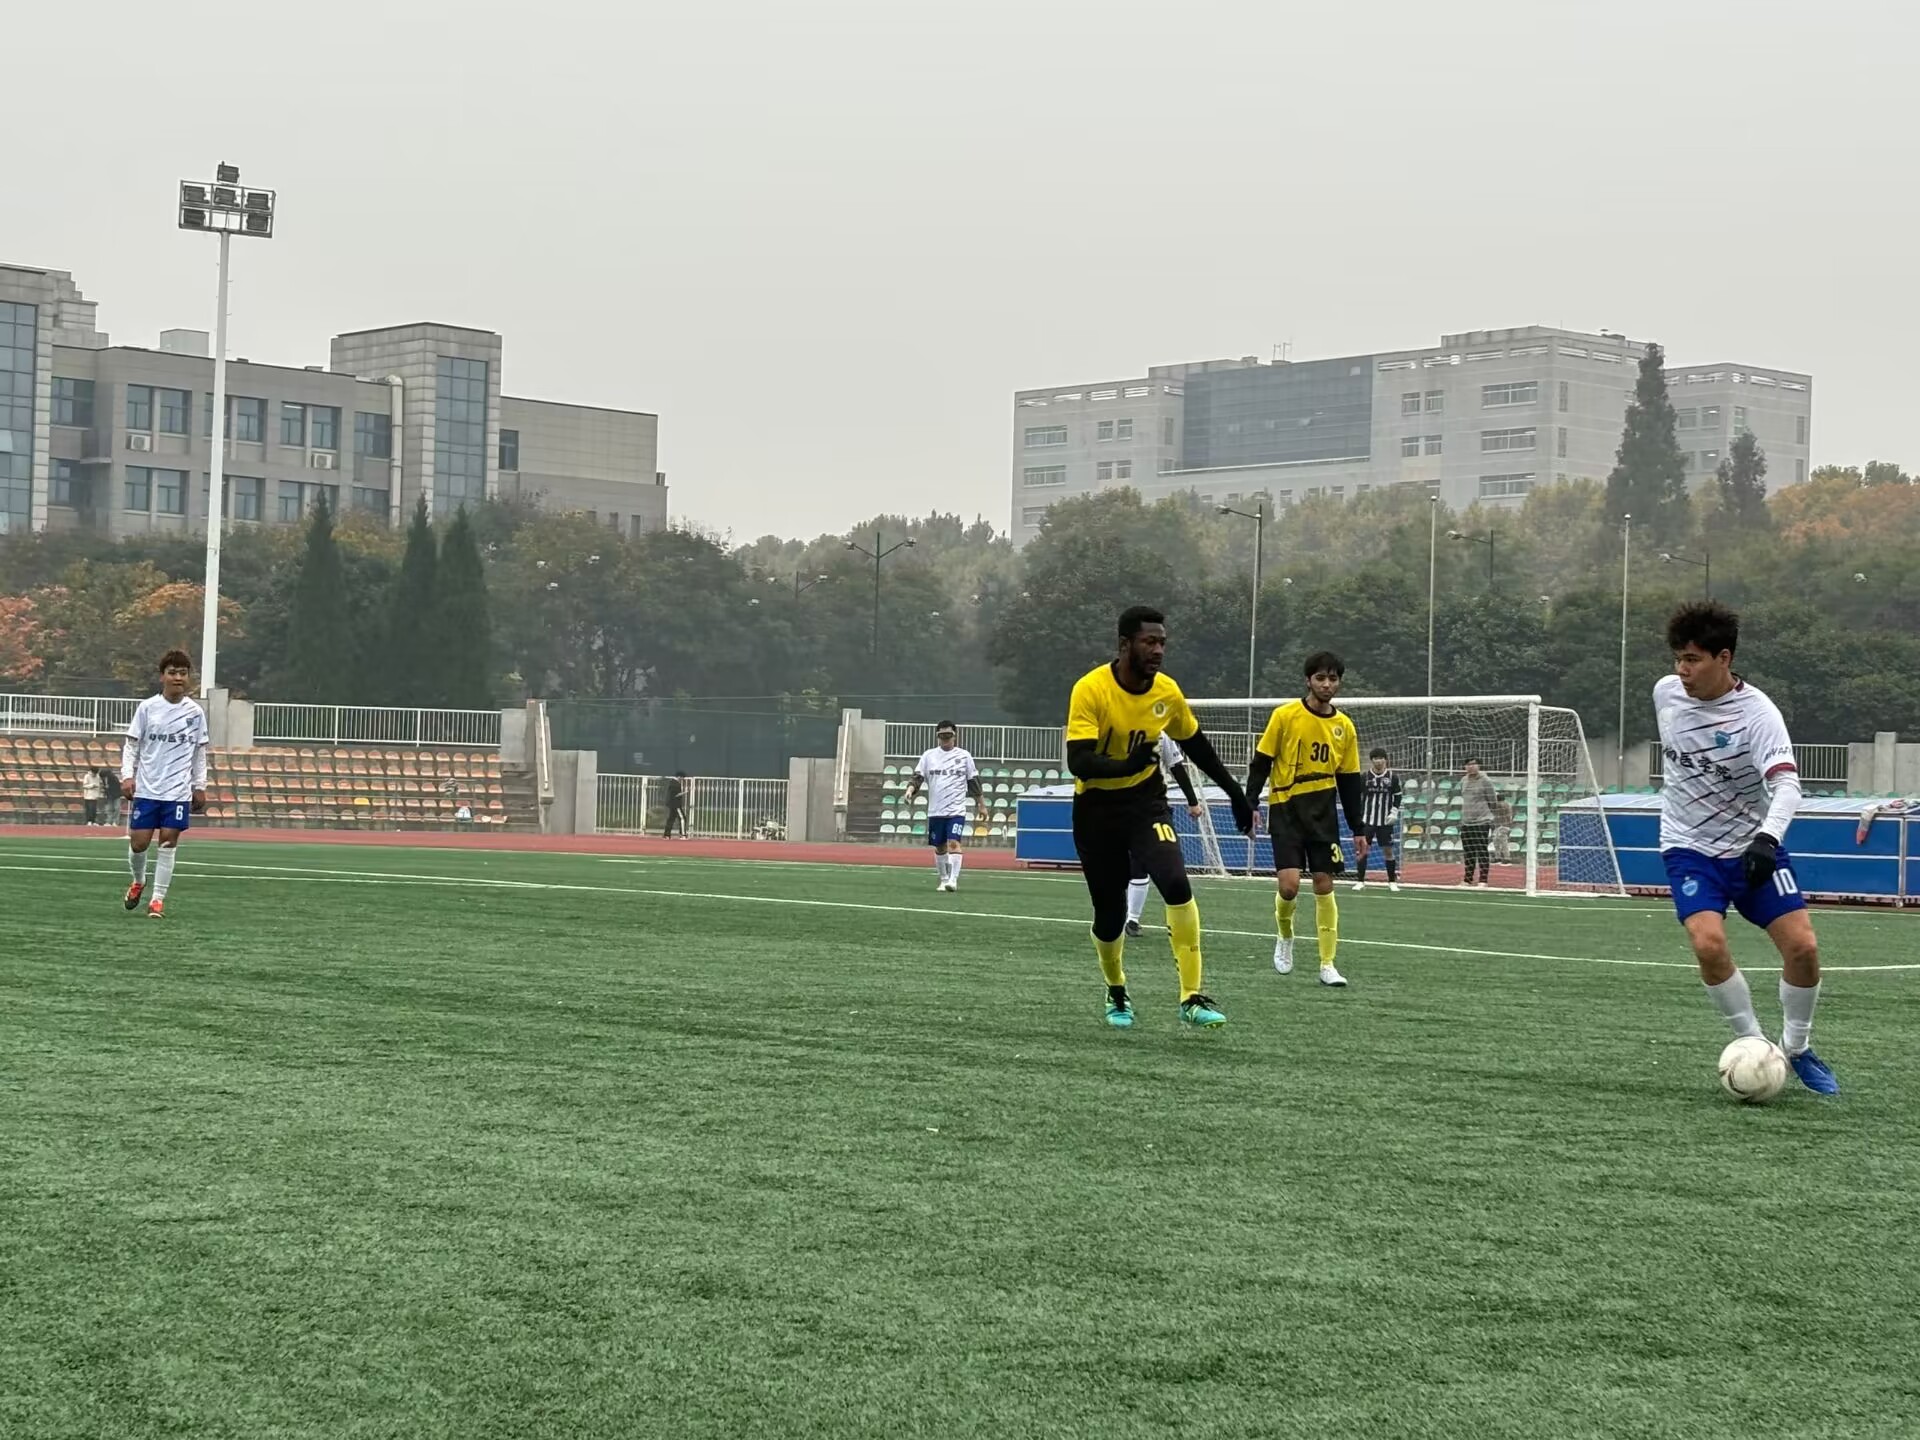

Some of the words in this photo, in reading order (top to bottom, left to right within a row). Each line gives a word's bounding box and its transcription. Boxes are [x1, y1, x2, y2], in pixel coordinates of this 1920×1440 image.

[1310, 742, 1329, 763] 30
[1153, 822, 1177, 843] 10
[1772, 868, 1798, 896] 10
